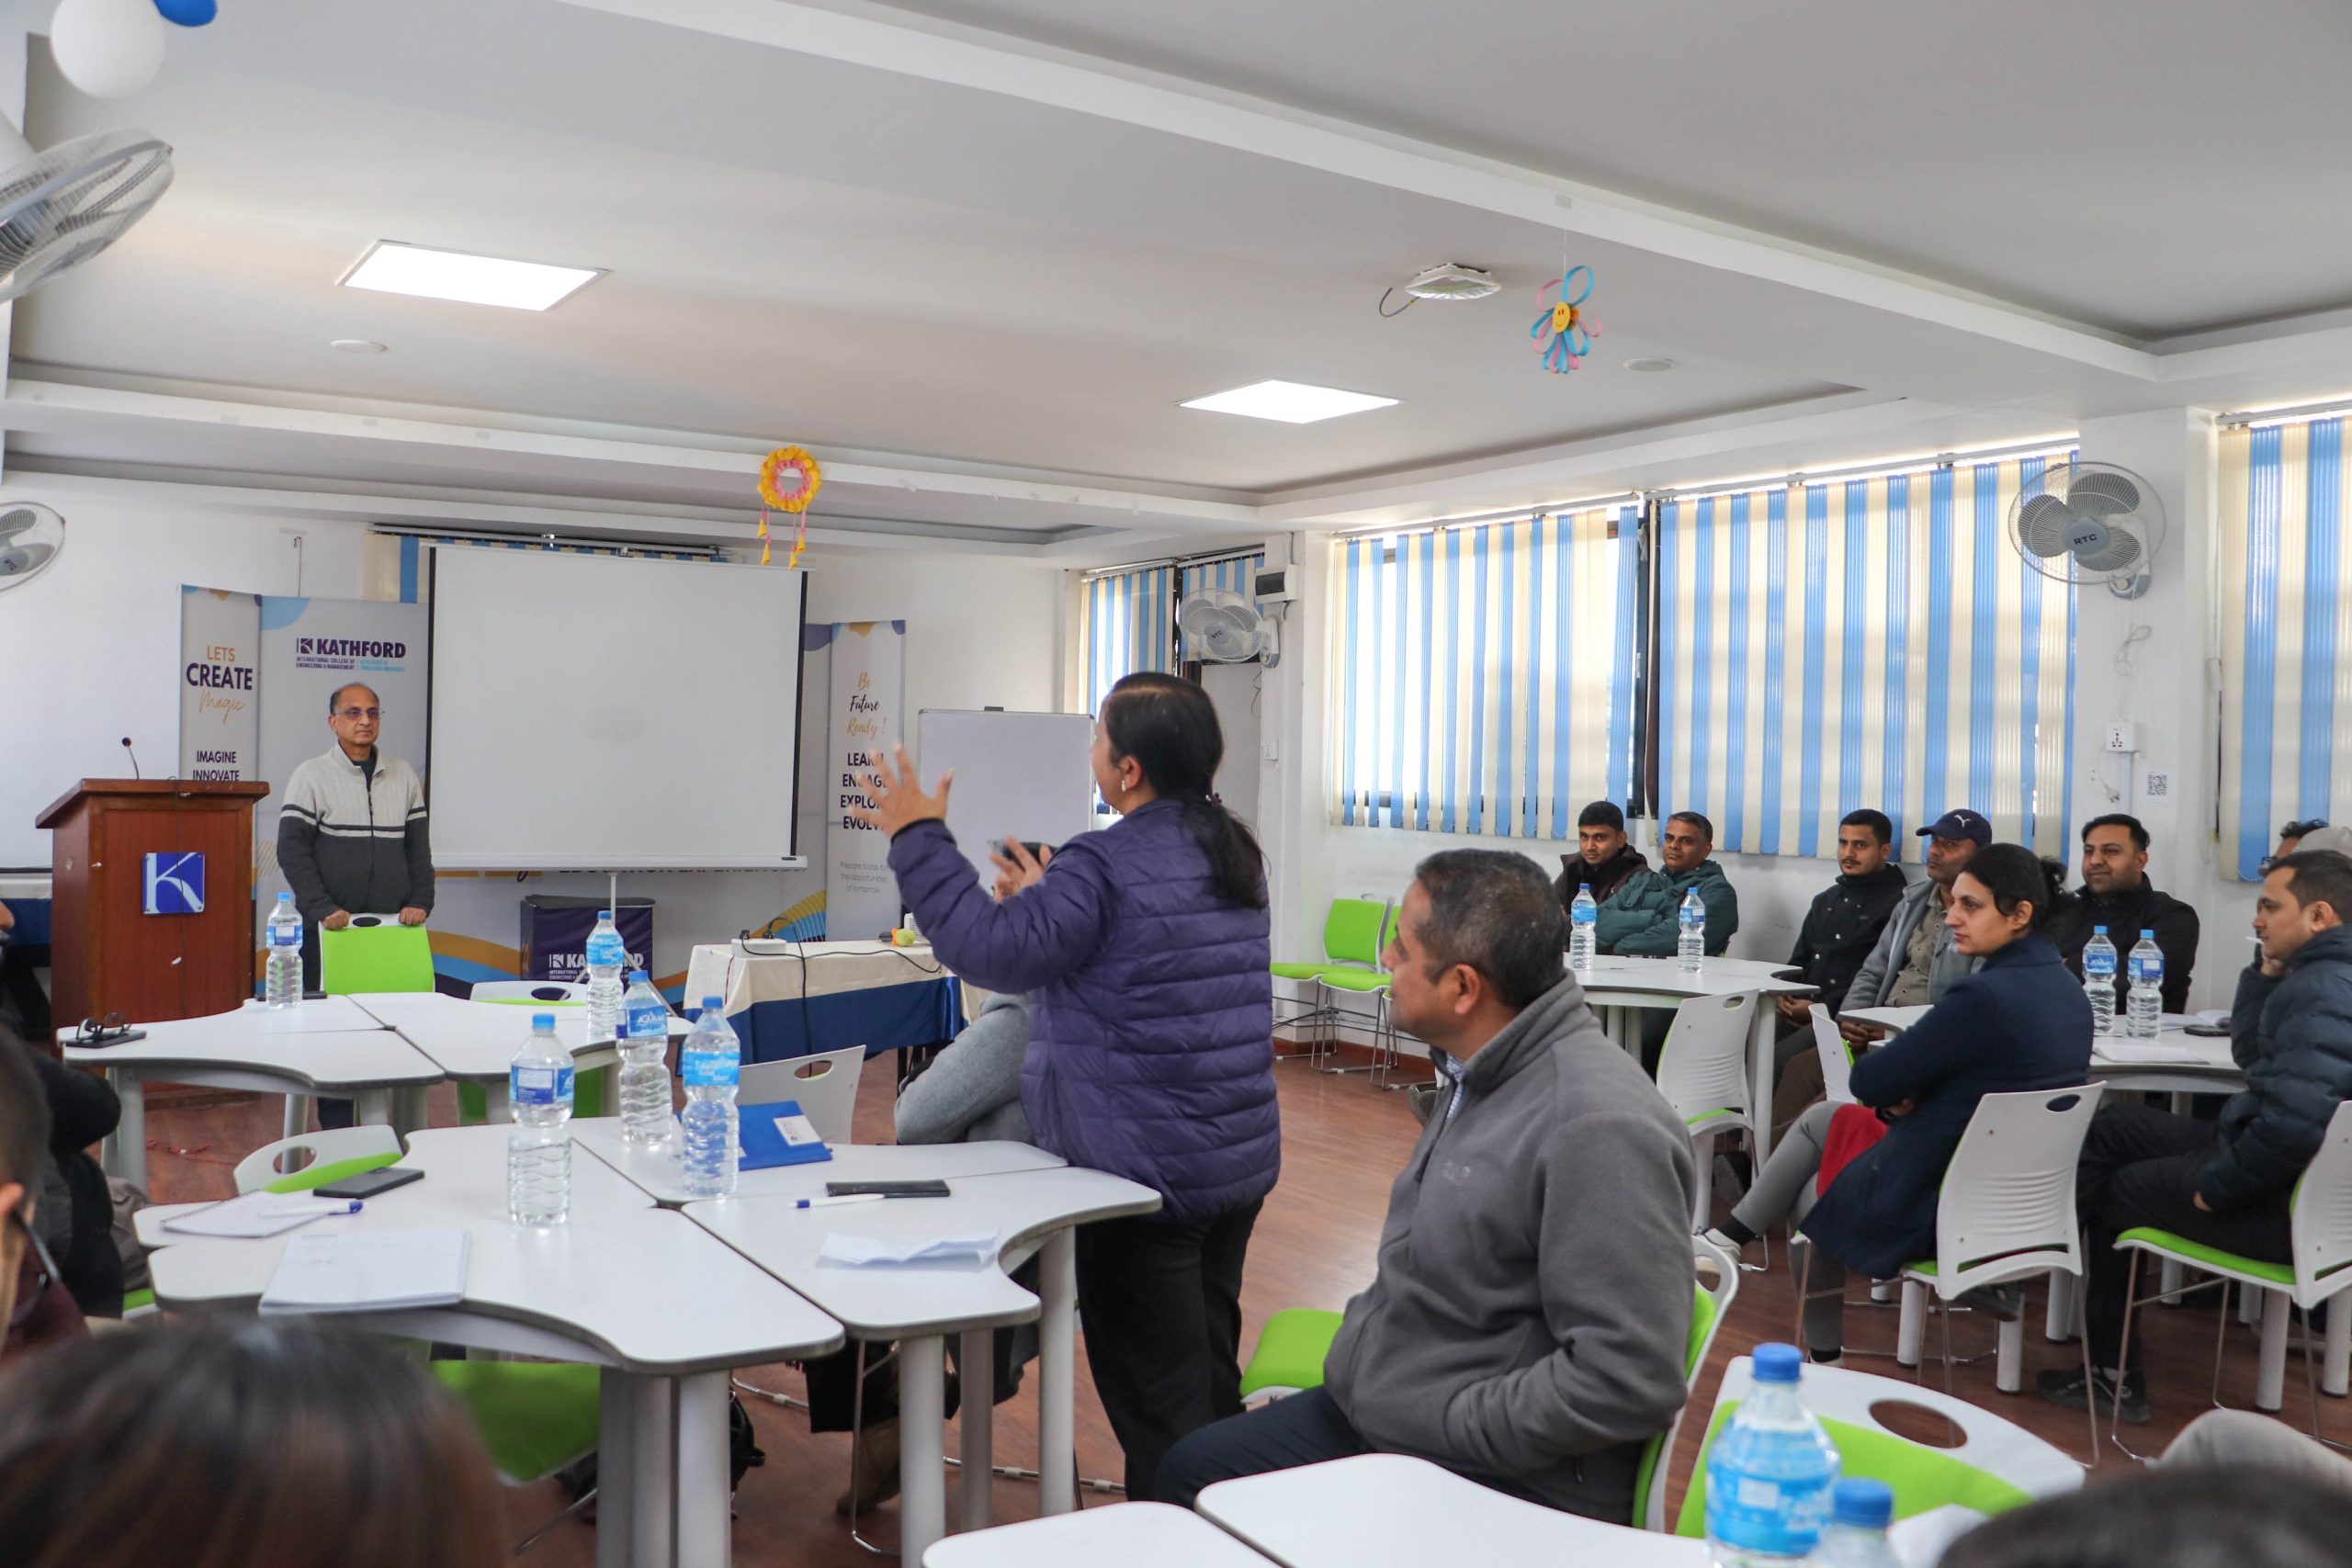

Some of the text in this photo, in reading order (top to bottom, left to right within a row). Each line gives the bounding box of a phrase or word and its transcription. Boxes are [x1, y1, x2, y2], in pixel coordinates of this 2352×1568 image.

[2074, 534, 2098, 545] RTC
[207, 646, 236, 662] LETS
[317, 638, 406, 658] KATHFORD
[187, 662, 253, 691] CREATE
[199, 690, 245, 724] Magic
[849, 694, 880, 714] Future
[196, 750, 237, 763] IMAGINE
[193, 769, 240, 782] INNOVATE
